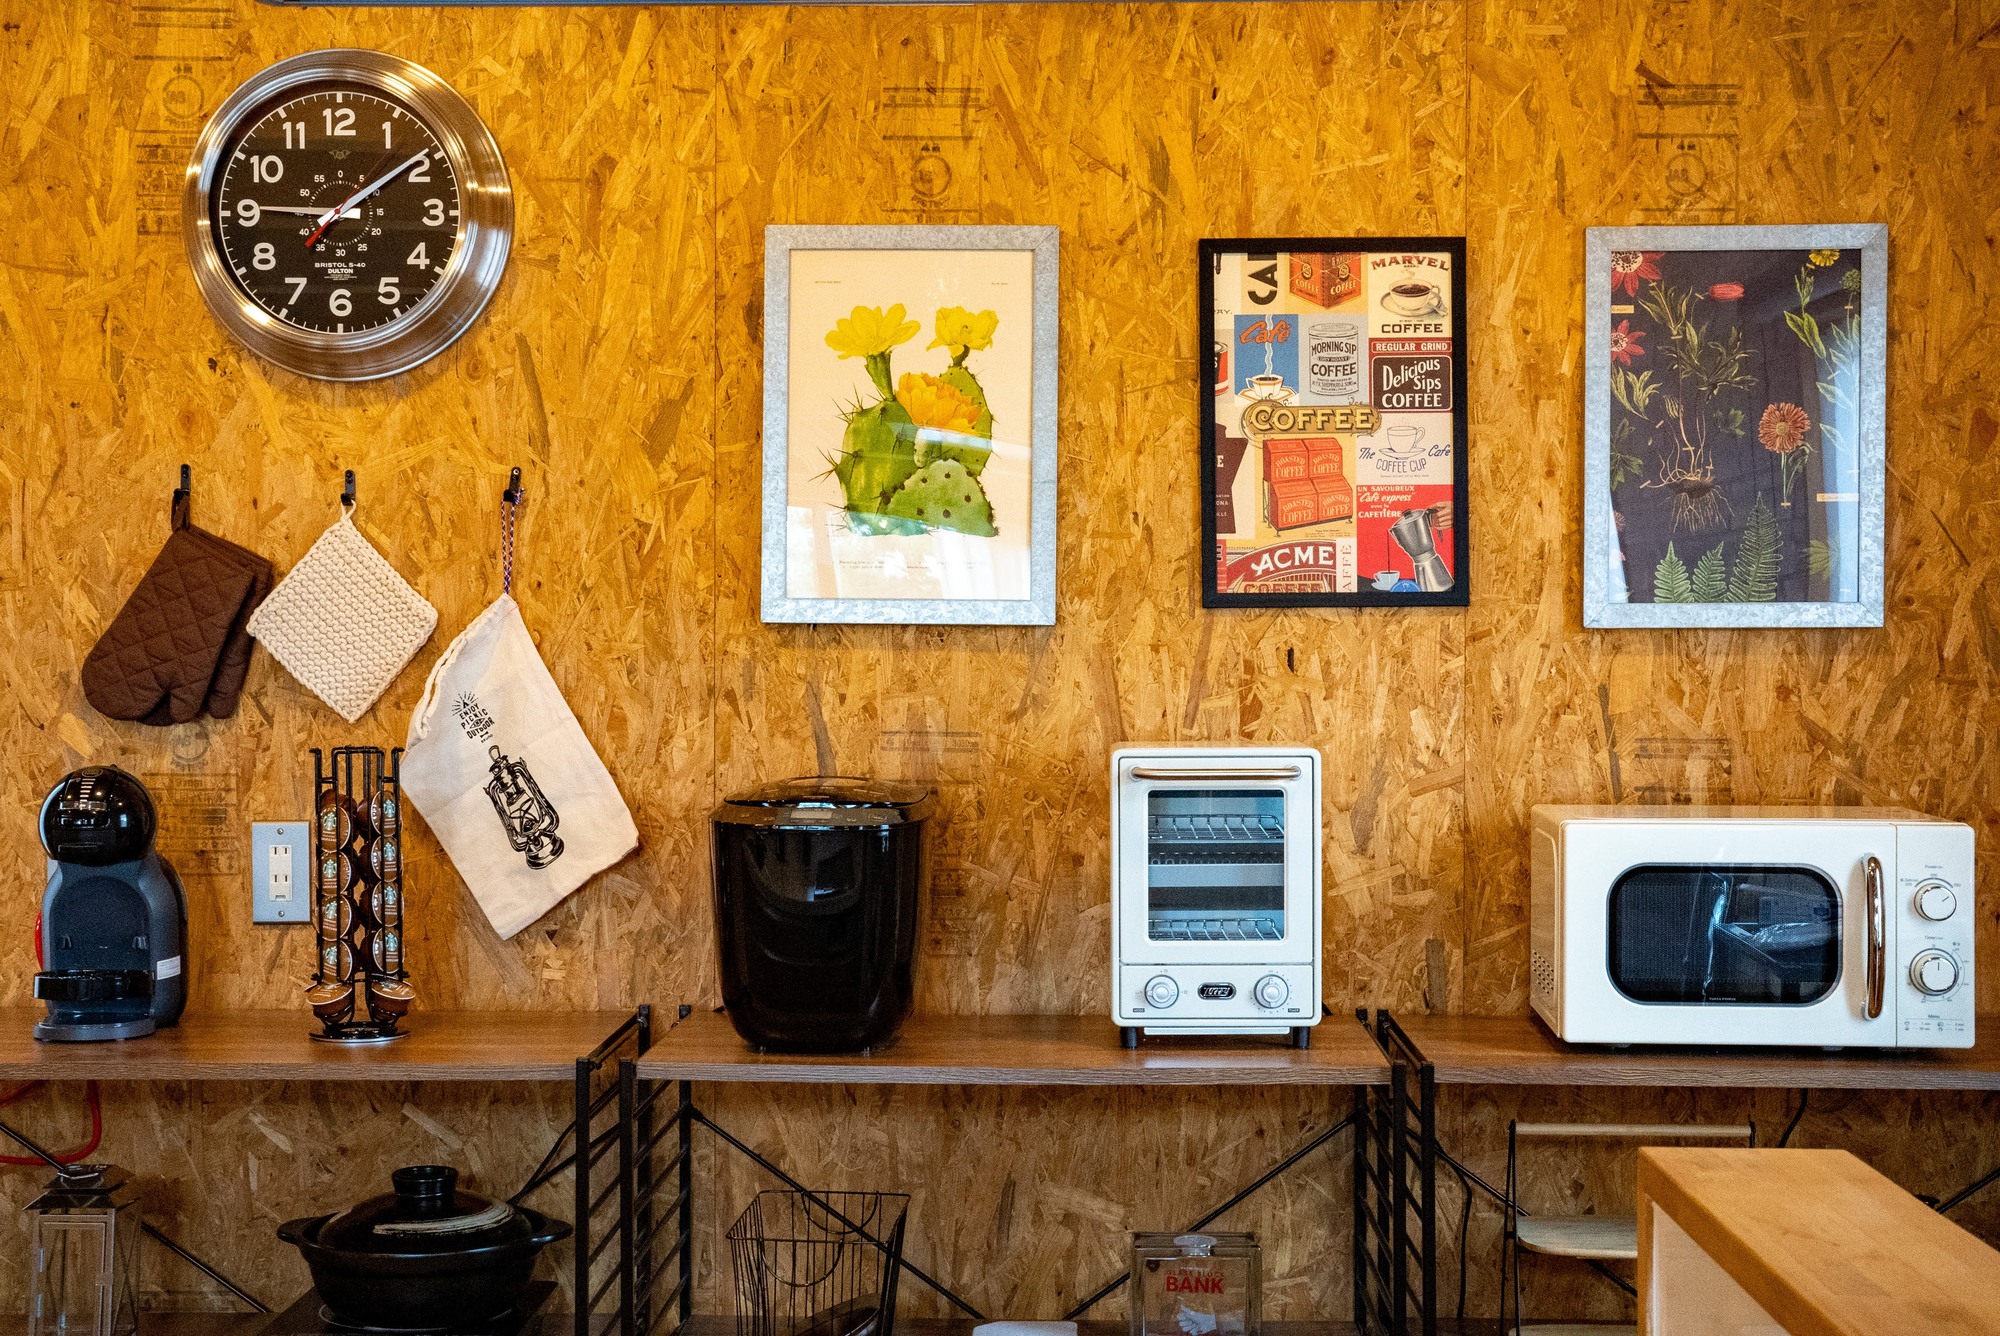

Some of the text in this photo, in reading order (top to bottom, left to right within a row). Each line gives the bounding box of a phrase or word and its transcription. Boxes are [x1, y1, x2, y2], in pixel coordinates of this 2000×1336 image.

[322, 108, 356, 136] 12
[282, 121, 306, 149] 11
[381, 121, 392, 149] 1
[250, 155, 284, 183] 10
[337, 170, 343, 178] 0
[407, 153, 431, 182] 2
[314, 174, 325, 182] 55
[359, 174, 365, 182] 5
[300, 188, 310, 196] 50
[237, 198, 261, 227] 9
[376, 208, 384, 216] 15
[421, 198, 445, 227] 3
[299, 228, 310, 236] 40
[371, 228, 382, 236] 20
[315, 243, 326, 252] 35
[335, 249, 346, 257] 30
[357, 243, 368, 252] 25
[252, 242, 276, 271] 8
[406, 242, 430, 269] 4
[1371, 255, 1450, 271] MARVEL
[284, 277, 307, 305] 7
[377, 277, 400, 305] 5
[1295, 279, 1319, 294] COFFEE
[1330, 280, 1357, 295] COFFEE
[329, 288, 352, 317] 6
[1239, 320, 1292, 344] Café
[1381, 323, 1443, 334] COFFEE
[1311, 341, 1357, 356] MORNING SIP
[1376, 342, 1448, 351] REGULAR GRIND
[1311, 362, 1357, 377] COFFEE
[1382, 359, 1441, 391] Delicious
[1413, 375, 1442, 393] Sips
[1381, 393, 1443, 408] COFFEE
[1250, 405, 1376, 431] COFFEE
[1275, 456, 1306, 467] ROASTED
[1312, 454, 1340, 464] ROASTED
[1359, 447, 1376, 460] The
[1376, 458, 1408, 473] COFFEE
[1409, 457, 1427, 472] CUP
[1275, 465, 1306, 478] COFFEE
[1313, 463, 1340, 474] COFFEE
[1282, 499, 1314, 512] ROASTED
[1322, 495, 1350, 506] ROASTED
[1283, 508, 1314, 524] COFFEE
[1322, 504, 1351, 517] COFFEE
[1250, 545, 1335, 577] ACME
[459, 702, 480, 720] ENJOY
[461, 708, 488, 730] PICNIC
[466, 716, 495, 739] OUTDOOR
[1165, 1276, 1225, 1295] BANK
